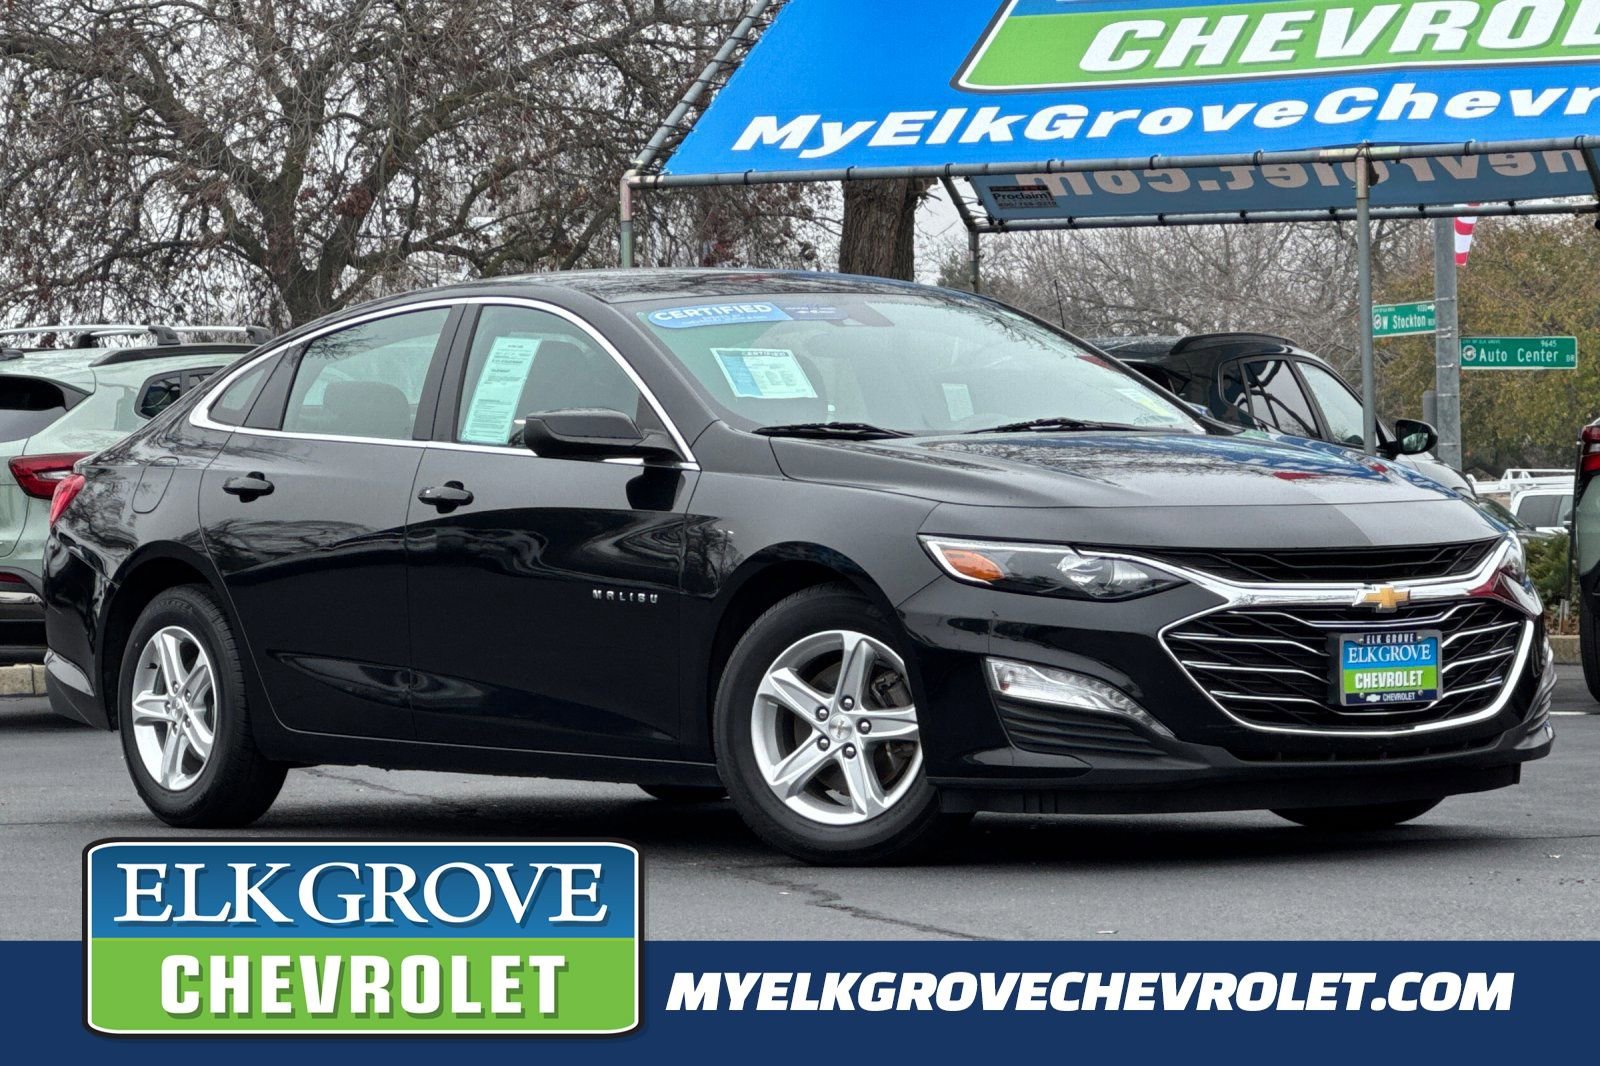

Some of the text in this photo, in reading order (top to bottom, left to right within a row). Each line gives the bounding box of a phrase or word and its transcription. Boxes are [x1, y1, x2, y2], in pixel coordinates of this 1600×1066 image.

[653, 304, 773, 321] CERTIFIED
[1382, 316, 1389, 330] W
[1392, 314, 1426, 330] Stockton
[1479, 348, 1508, 362] Auto
[1517, 348, 1558, 362] Center
[592, 589, 658, 604] MALIBU
[1366, 633, 1414, 644] ELK GROVE
[1347, 644, 1431, 664] ELK GROVE
[1355, 670, 1424, 689] CHEVROLET
[1383, 692, 1416, 702] CHEVROLET
